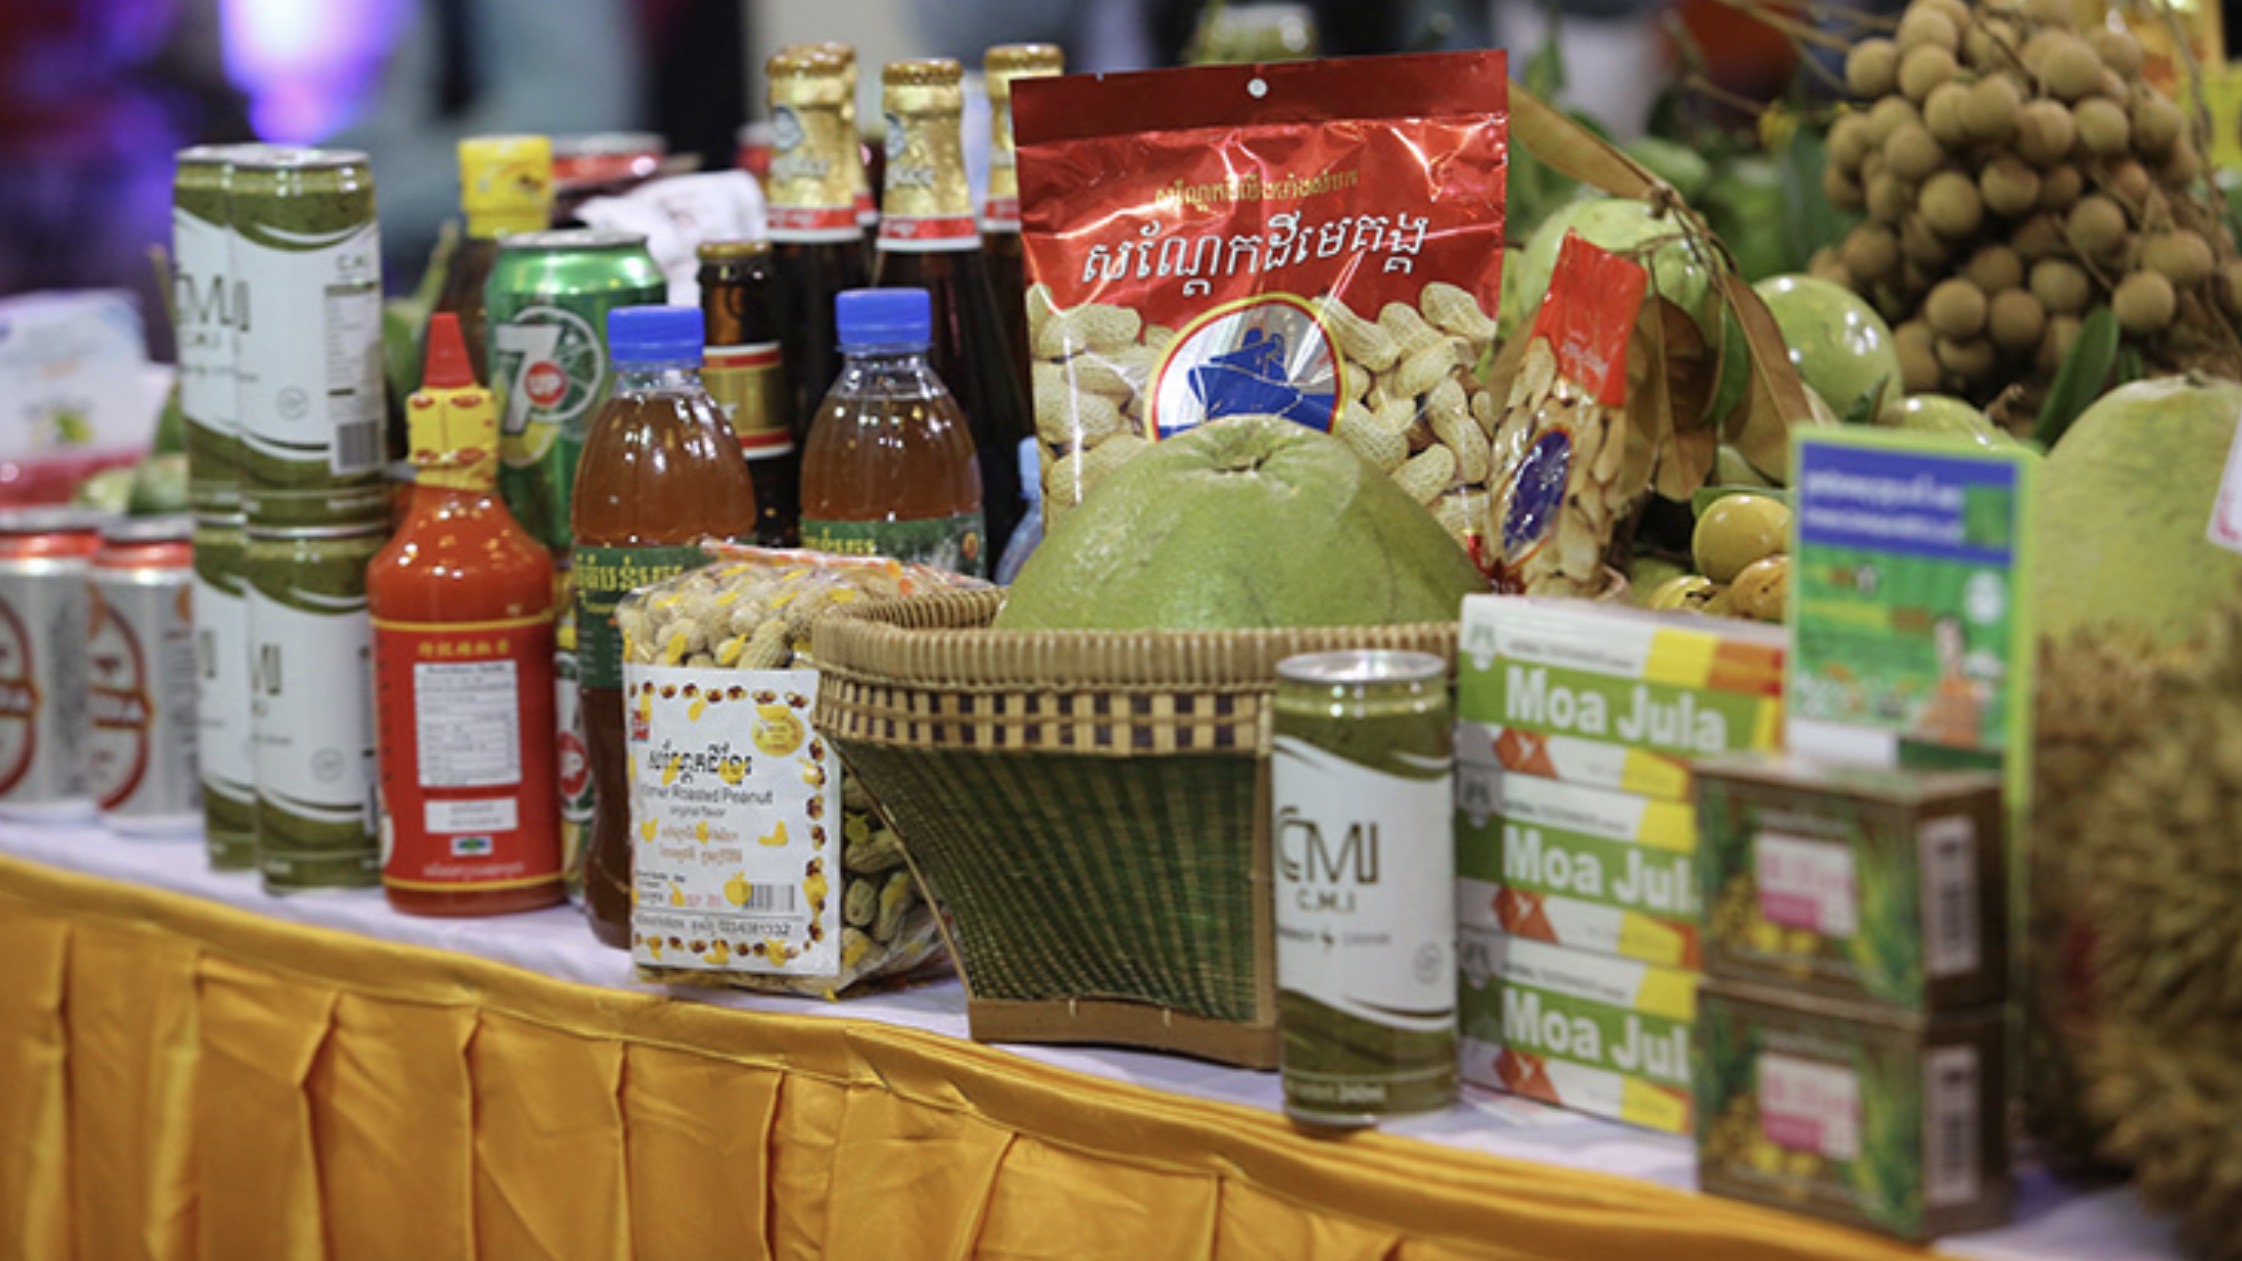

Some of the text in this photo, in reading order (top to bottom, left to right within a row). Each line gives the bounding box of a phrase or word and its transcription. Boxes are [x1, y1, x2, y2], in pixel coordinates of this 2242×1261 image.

[1504, 666, 1728, 752] Moa Jula
[723, 789, 774, 805] Peanut
[1503, 825, 1603, 896] Moa
[1613, 848, 1703, 914] Jul
[1502, 986, 1603, 1062] Moa
[1610, 1015, 1691, 1084] Jul
